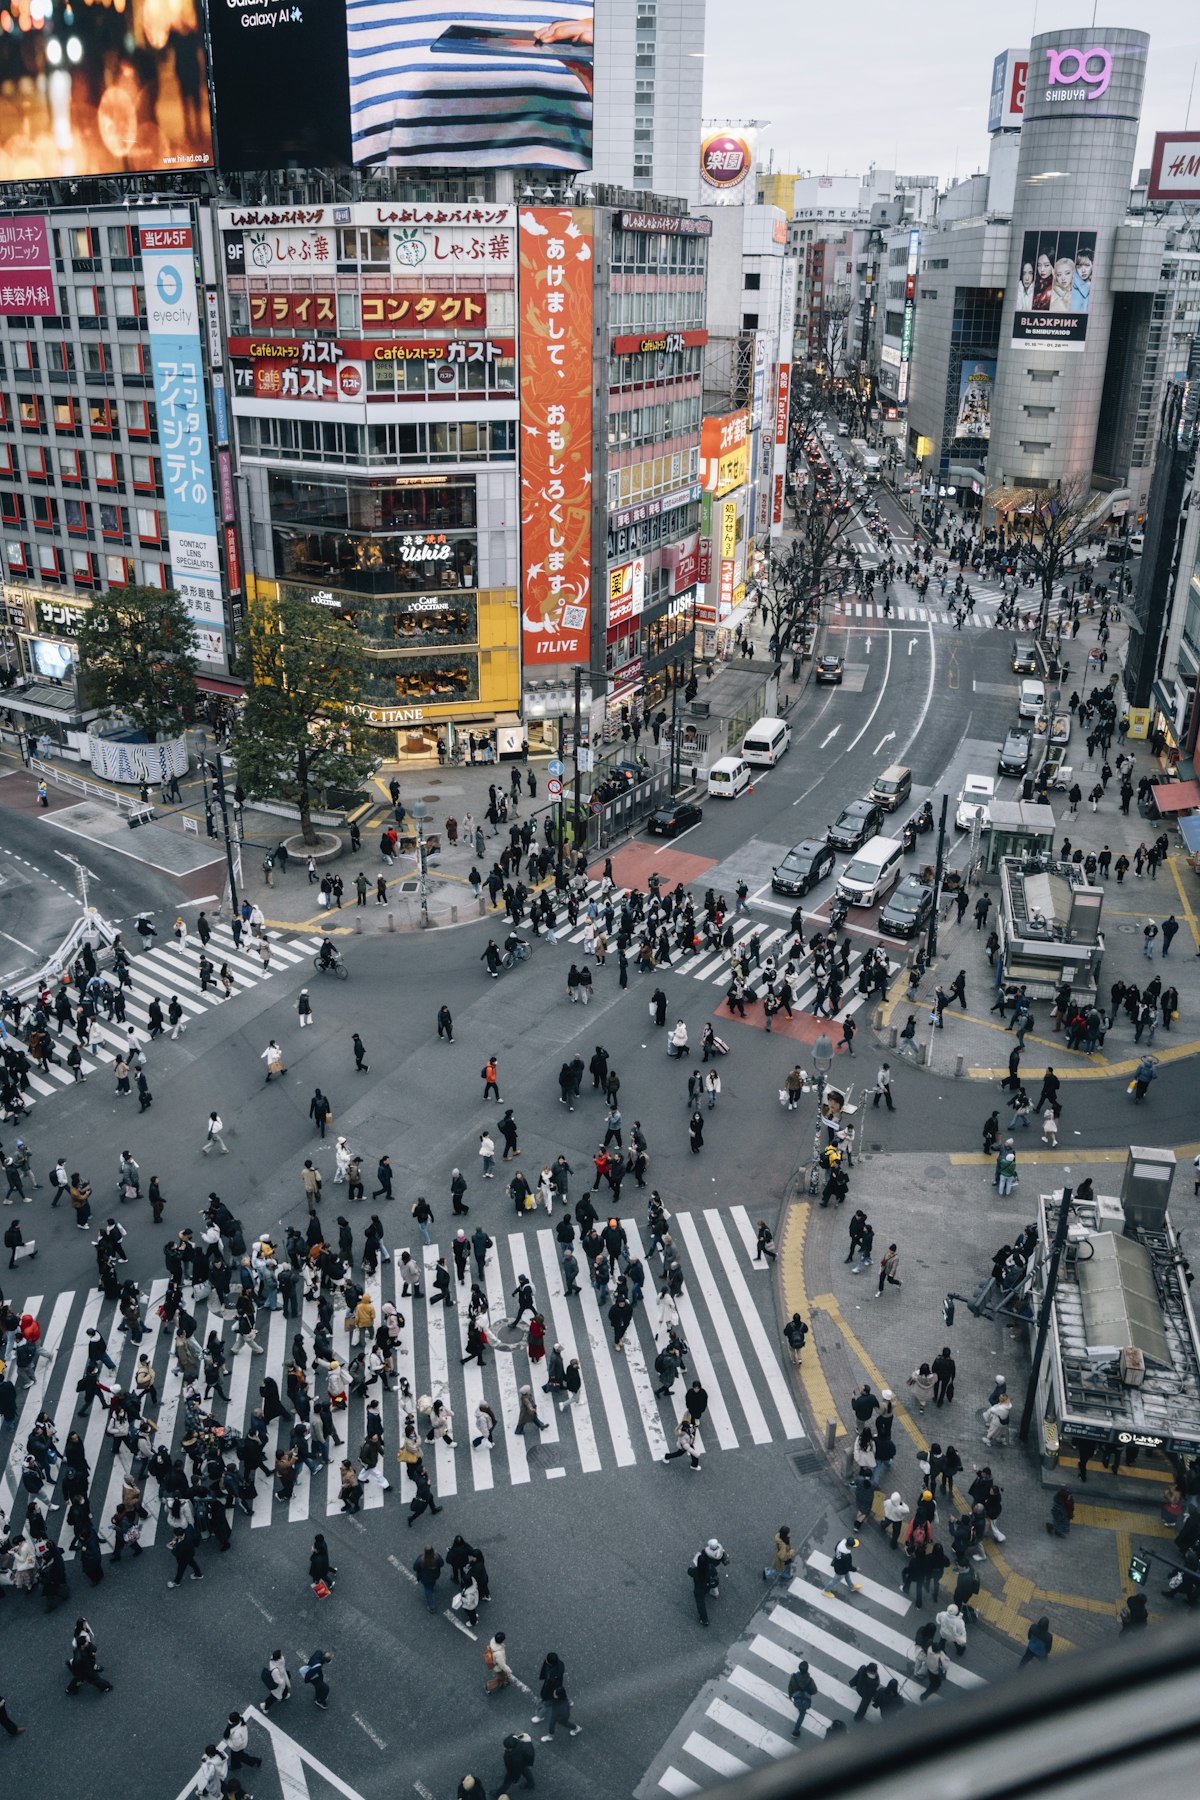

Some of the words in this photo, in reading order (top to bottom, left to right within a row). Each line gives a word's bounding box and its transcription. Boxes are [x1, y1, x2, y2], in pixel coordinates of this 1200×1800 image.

[241, 12, 278, 28] Galaxy
[278, 8, 290, 23] AI
[1046, 47, 1113, 100] 109
[1045, 89, 1086, 102] SHIBUYA
[706, 150, 744, 171] 楽園
[1167, 154, 1200, 178] H&M
[230, 208, 325, 226] しゃぶしゃぶバイキング
[377, 207, 509, 224] しゃぶしゃぶバイキング
[144, 230, 187, 247] 当ビル5F
[276, 236, 329, 261] しゃぶ葉
[434, 234, 510, 260] しゃぶ葉
[227, 244, 243, 260] 9F
[251, 297, 336, 322] プライス
[362, 298, 482, 322] コンタクト
[546, 237, 566, 378] あけまして、
[153, 309, 192, 327] eyecity
[209, 310, 220, 358] 献血ルーム
[665, 333, 686, 353] ガスト
[301, 340, 343, 363] ガスト
[447, 341, 503, 363] ガスト
[235, 369, 254, 386] 7F
[258, 369, 280, 383] Café
[282, 366, 333, 397] ガスト
[342, 379, 360, 388] ガスト
[777, 395, 788, 437] TaxFree
[157, 361, 189, 502] アイシティ
[182, 362, 208, 504] コンタクトの
[691, 485, 703, 500] 4F
[547, 404, 566, 606] おもしろくします。
[179, 539, 207, 550] CONTACT
[186, 550, 202, 558] LENS
[399, 543, 452, 562] Ushi8
[176, 556, 214, 569] SPECIALISTS
[679, 560, 695, 577] アコム
[181, 584, 215, 599] 隐形眼镜
[187, 599, 212, 613] 专卖店
[668, 591, 692, 620] LUSH
[536, 639, 579, 654] 17LIVE
